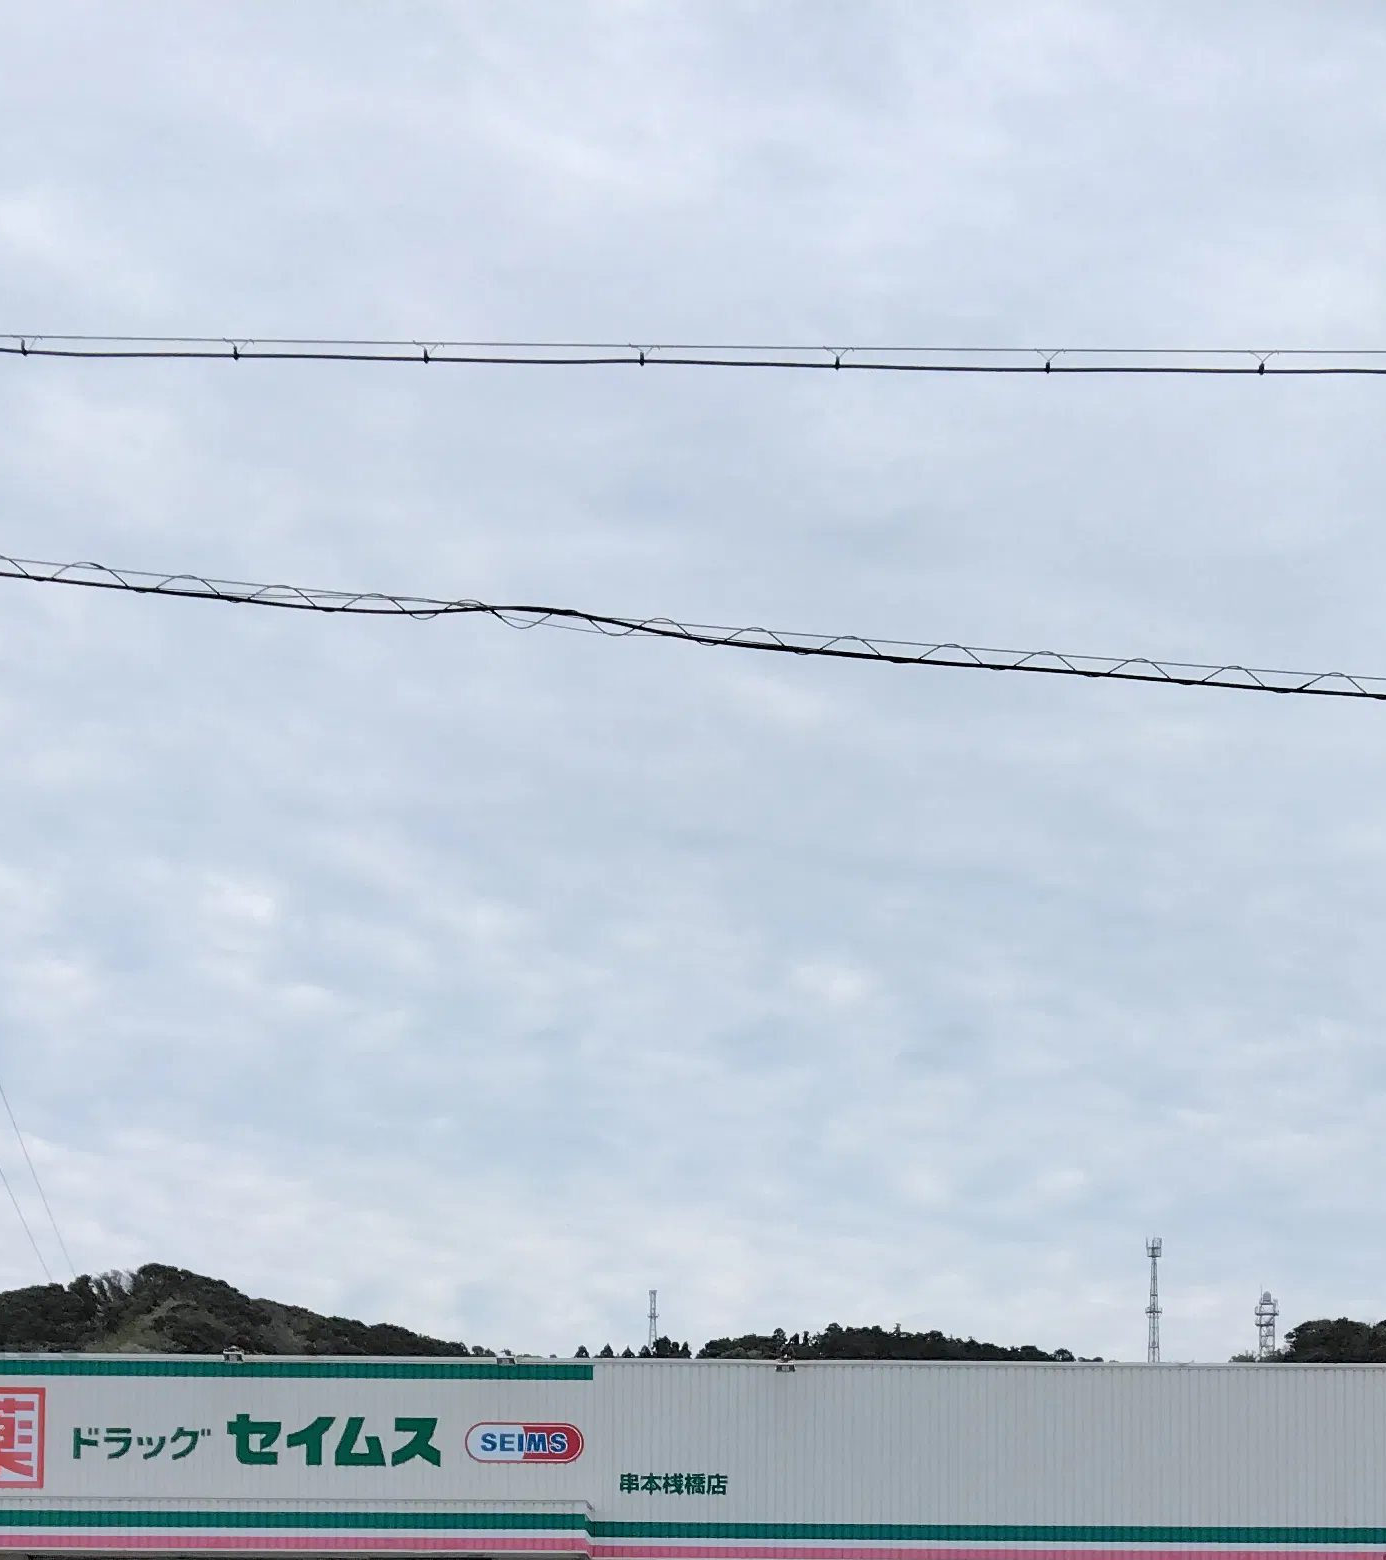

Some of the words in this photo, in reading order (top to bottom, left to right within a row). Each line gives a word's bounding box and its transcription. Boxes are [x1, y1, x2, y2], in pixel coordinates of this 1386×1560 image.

[73, 1426, 212, 1460] ドラッグ
[226, 1413, 441, 1468] セイムス
[480, 1431, 569, 1453] SEIMS
[619, 1472, 729, 1496] 串本桟橋店
